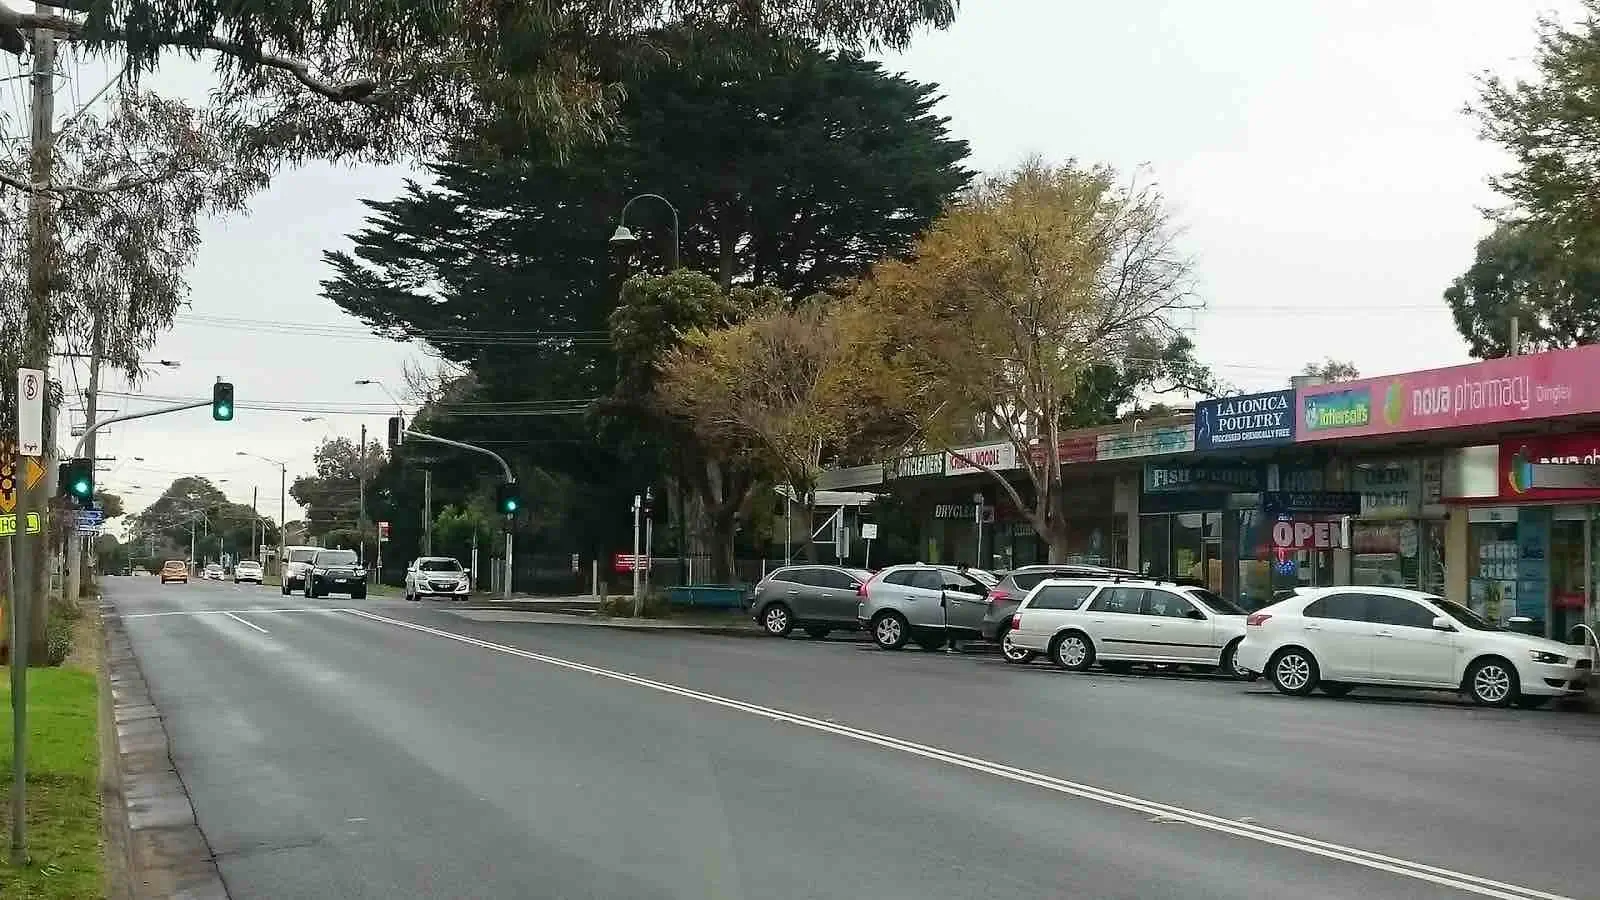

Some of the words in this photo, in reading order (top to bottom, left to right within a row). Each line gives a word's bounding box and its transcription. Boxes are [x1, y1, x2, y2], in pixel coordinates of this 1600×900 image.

[1412, 386, 1449, 416] nova
[1454, 375, 1529, 416] pharmacy
[1219, 412, 1284, 431] POULTRY
[1276, 428, 1291, 438] FREE
